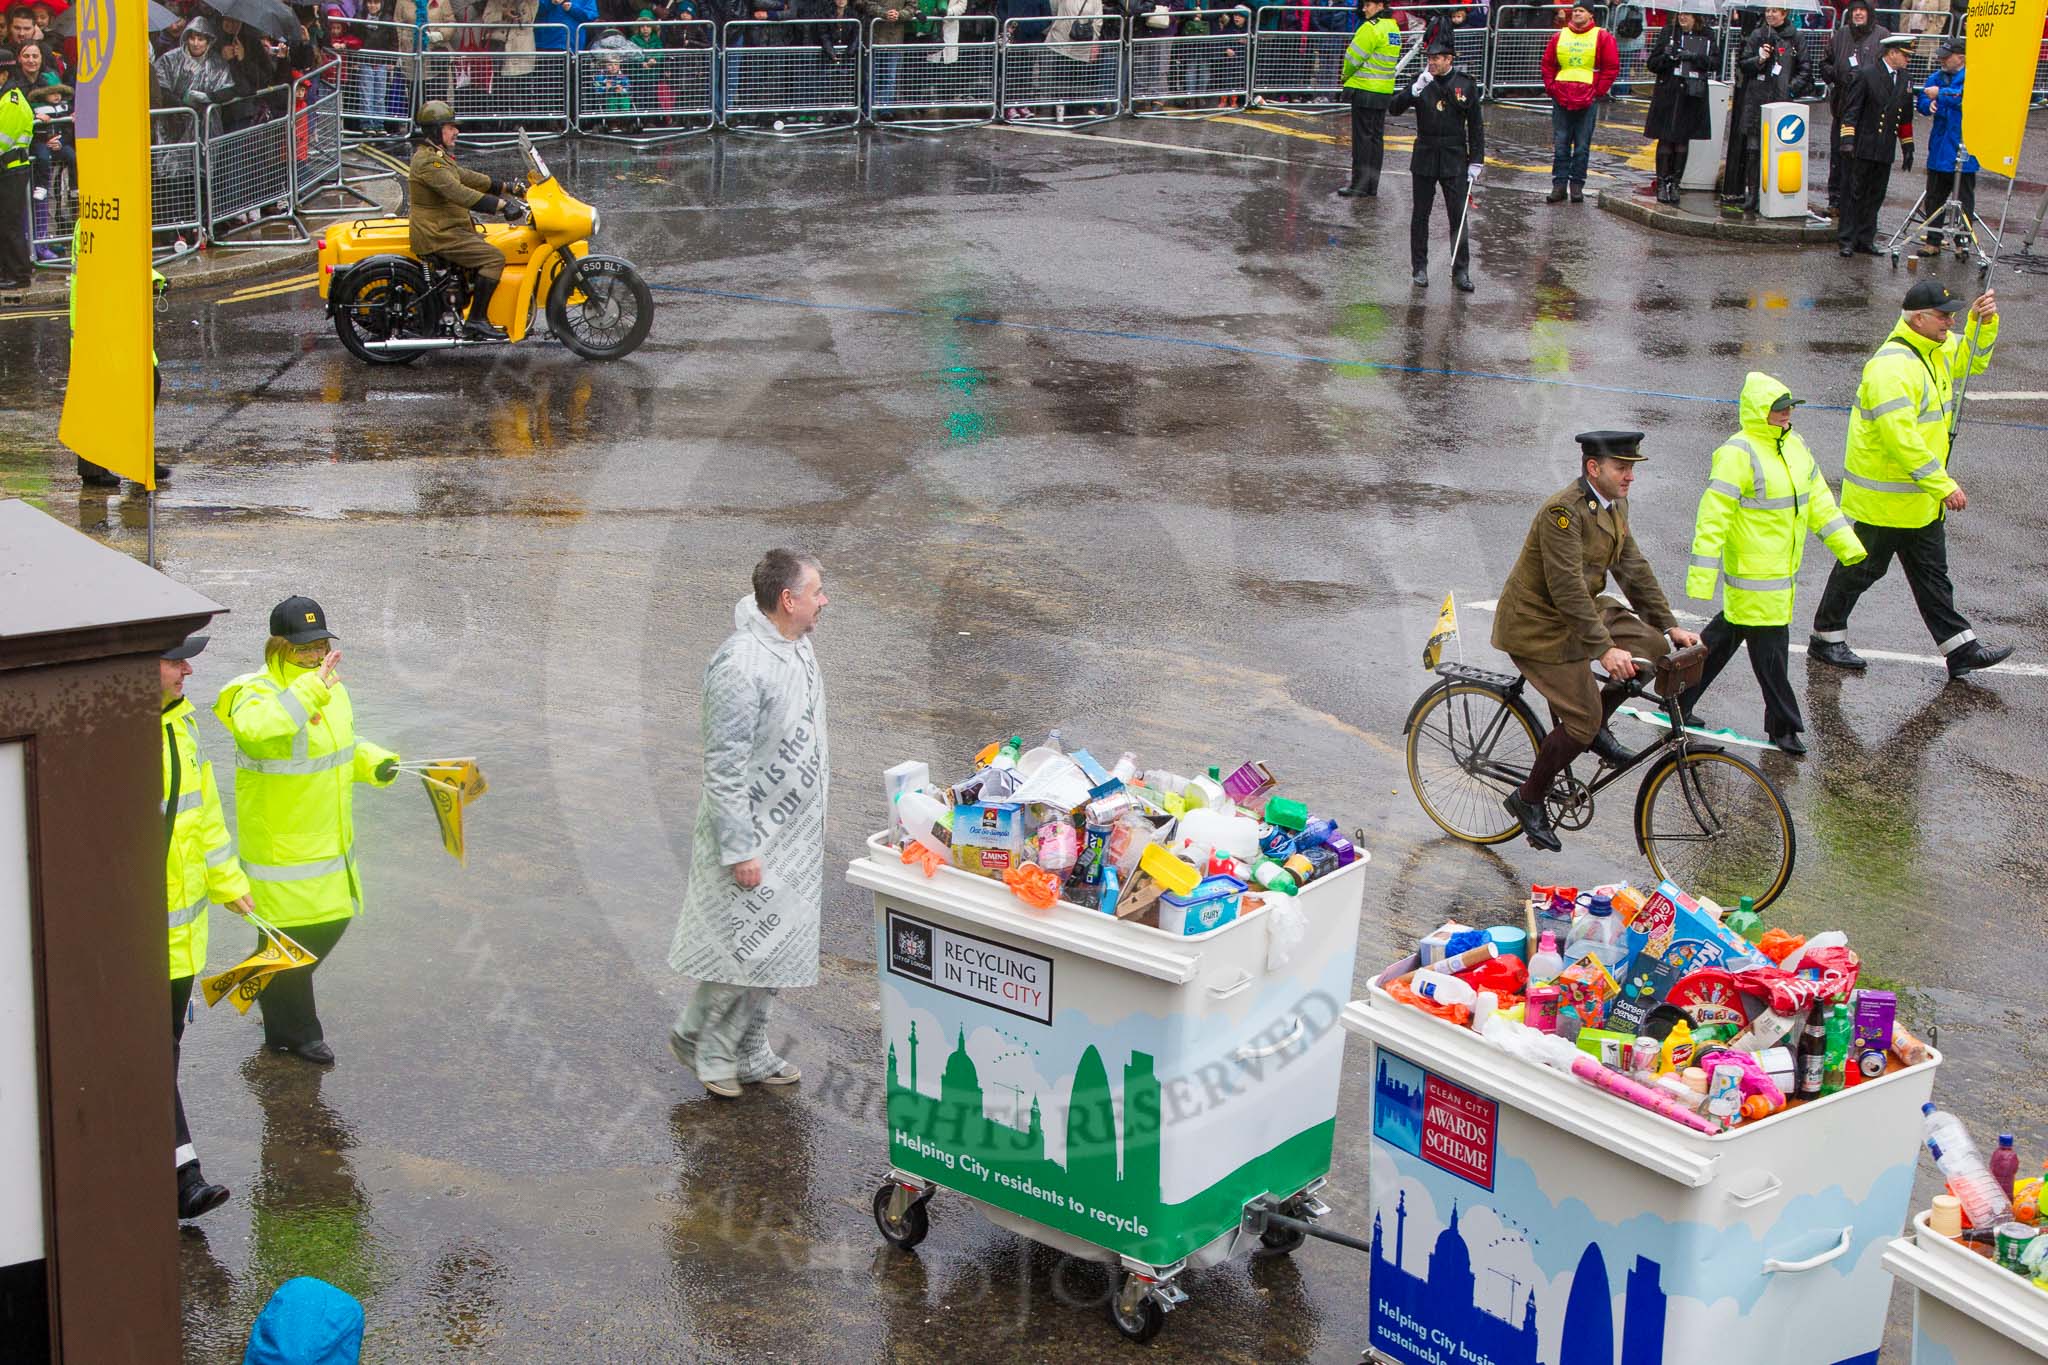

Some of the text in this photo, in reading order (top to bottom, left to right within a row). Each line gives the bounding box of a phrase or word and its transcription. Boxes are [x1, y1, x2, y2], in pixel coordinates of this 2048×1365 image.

[583, 261, 622, 272] 650 BLT
[758, 763, 786, 785] is
[778, 723, 809, 764] the
[769, 787, 802, 825] our
[742, 899, 761, 914] it
[753, 886, 775, 903] is
[1203, 910, 1219, 921] FAIRY
[910, 959, 932, 972] LONDON
[945, 941, 1036, 984] RECYCLING
[945, 963, 1042, 1007] IN THE CITY
[1430, 1084, 1489, 1117] CLEAN CITY
[1426, 1104, 1487, 1146] AWARDS
[1426, 1128, 1488, 1172] SCHEME
[895, 1129, 1149, 1238] Helping City residents to recycle
[1378, 1298, 1428, 1341] Helping
[1430, 1329, 1456, 1355] City
